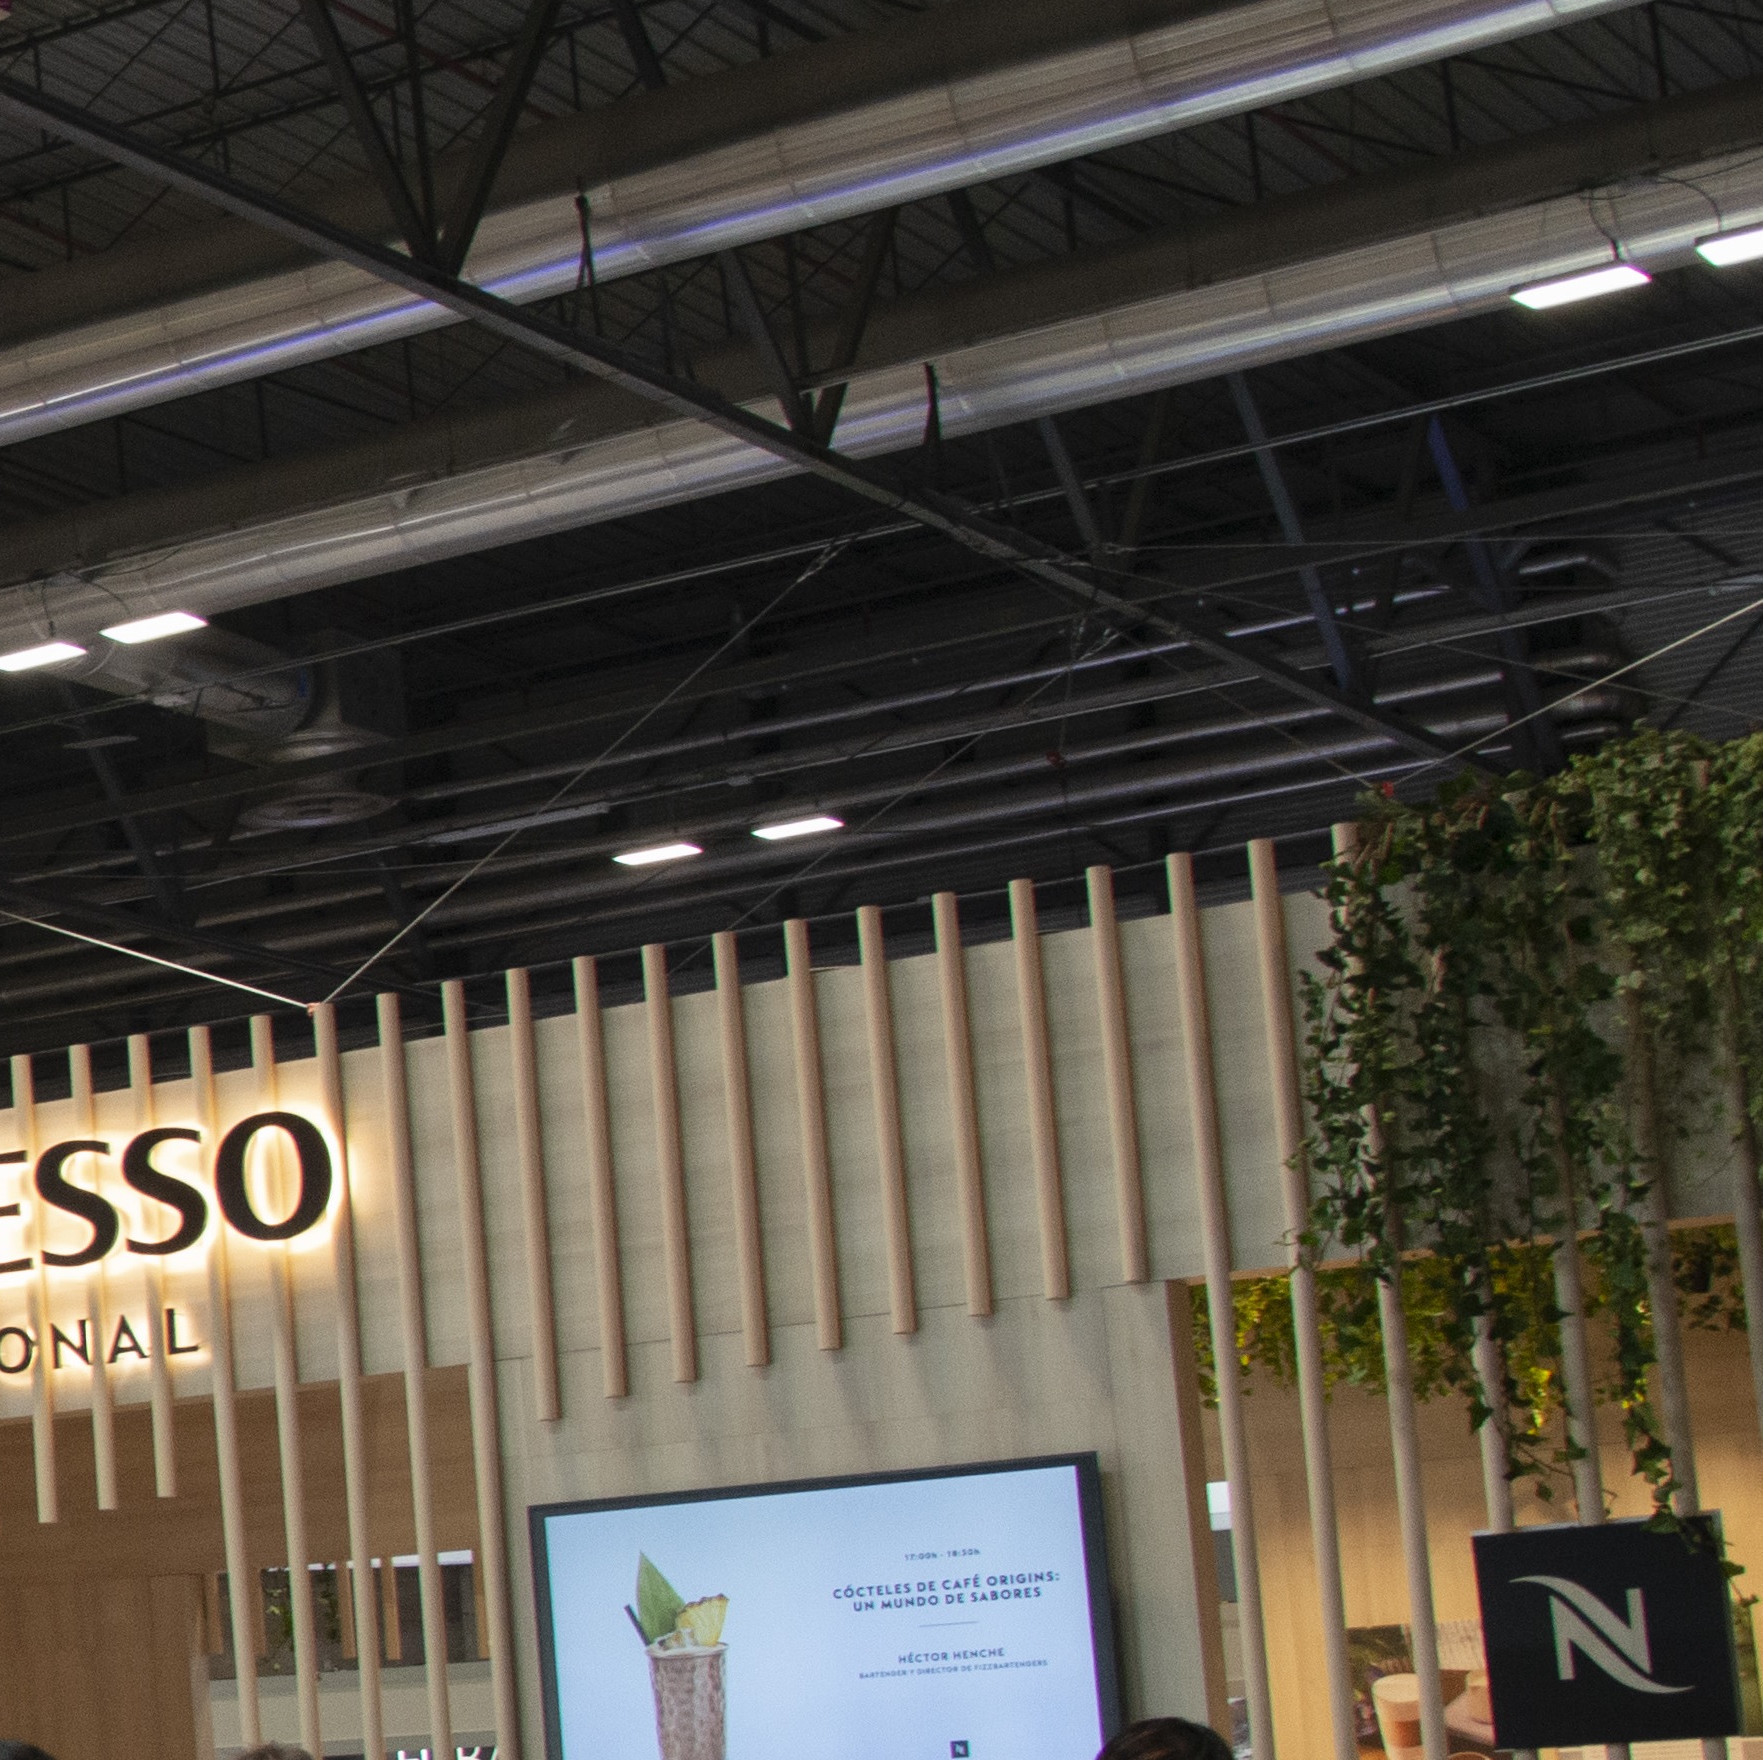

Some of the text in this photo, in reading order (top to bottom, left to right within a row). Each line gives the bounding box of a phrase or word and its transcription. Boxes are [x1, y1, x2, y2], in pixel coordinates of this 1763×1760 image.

[833, 1570, 1061, 1600] CÓCTELES DE CAFÉ ORIGINS:
[853, 1587, 1043, 1613] UN MUNDO DE SABORES
[898, 1652, 949, 1665] HÉCTOR
